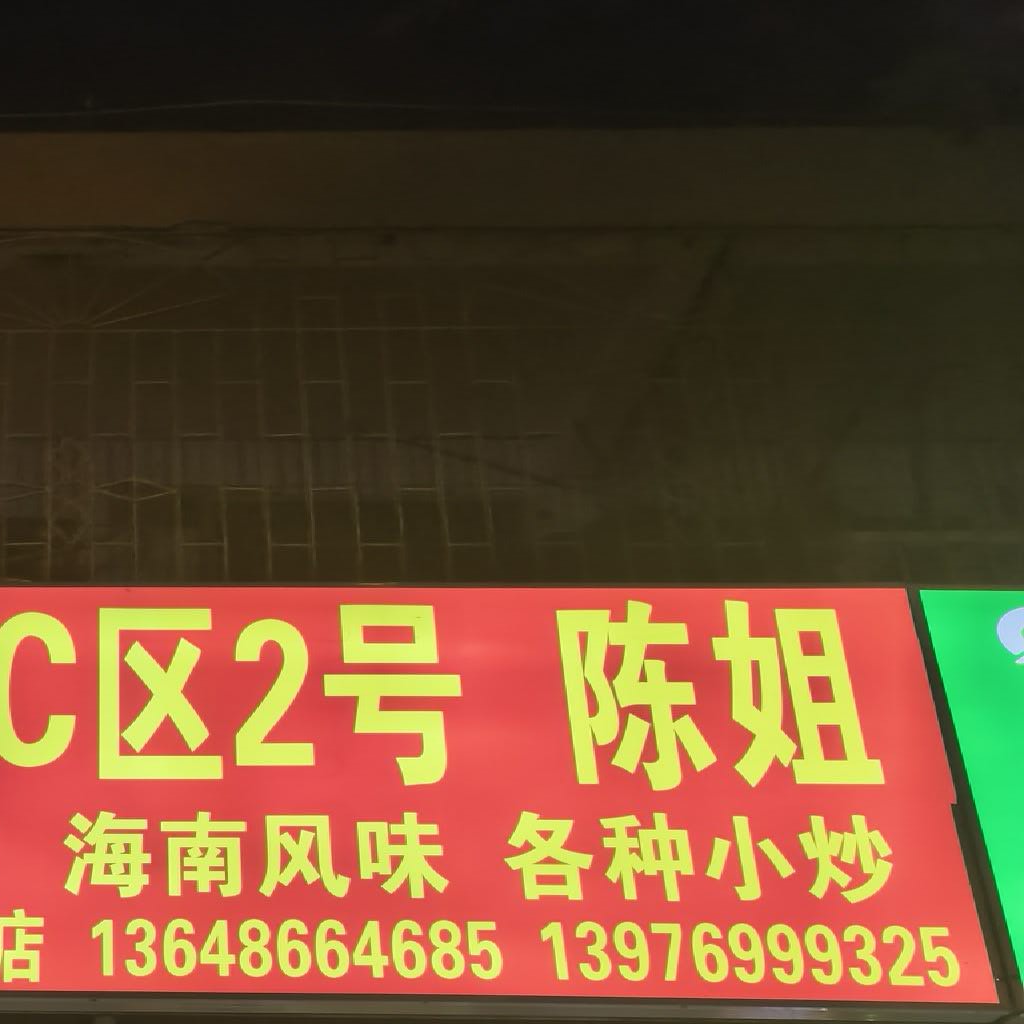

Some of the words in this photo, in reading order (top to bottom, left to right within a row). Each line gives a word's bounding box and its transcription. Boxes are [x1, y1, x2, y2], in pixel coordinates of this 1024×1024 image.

[556, 599, 885, 791] 陈姐
[64, 811, 449, 898] 海南风味
[504, 811, 893, 903] 各种小炒
[91, 918, 503, 981] 13648664685
[541, 921, 961, 988] 13976999325
